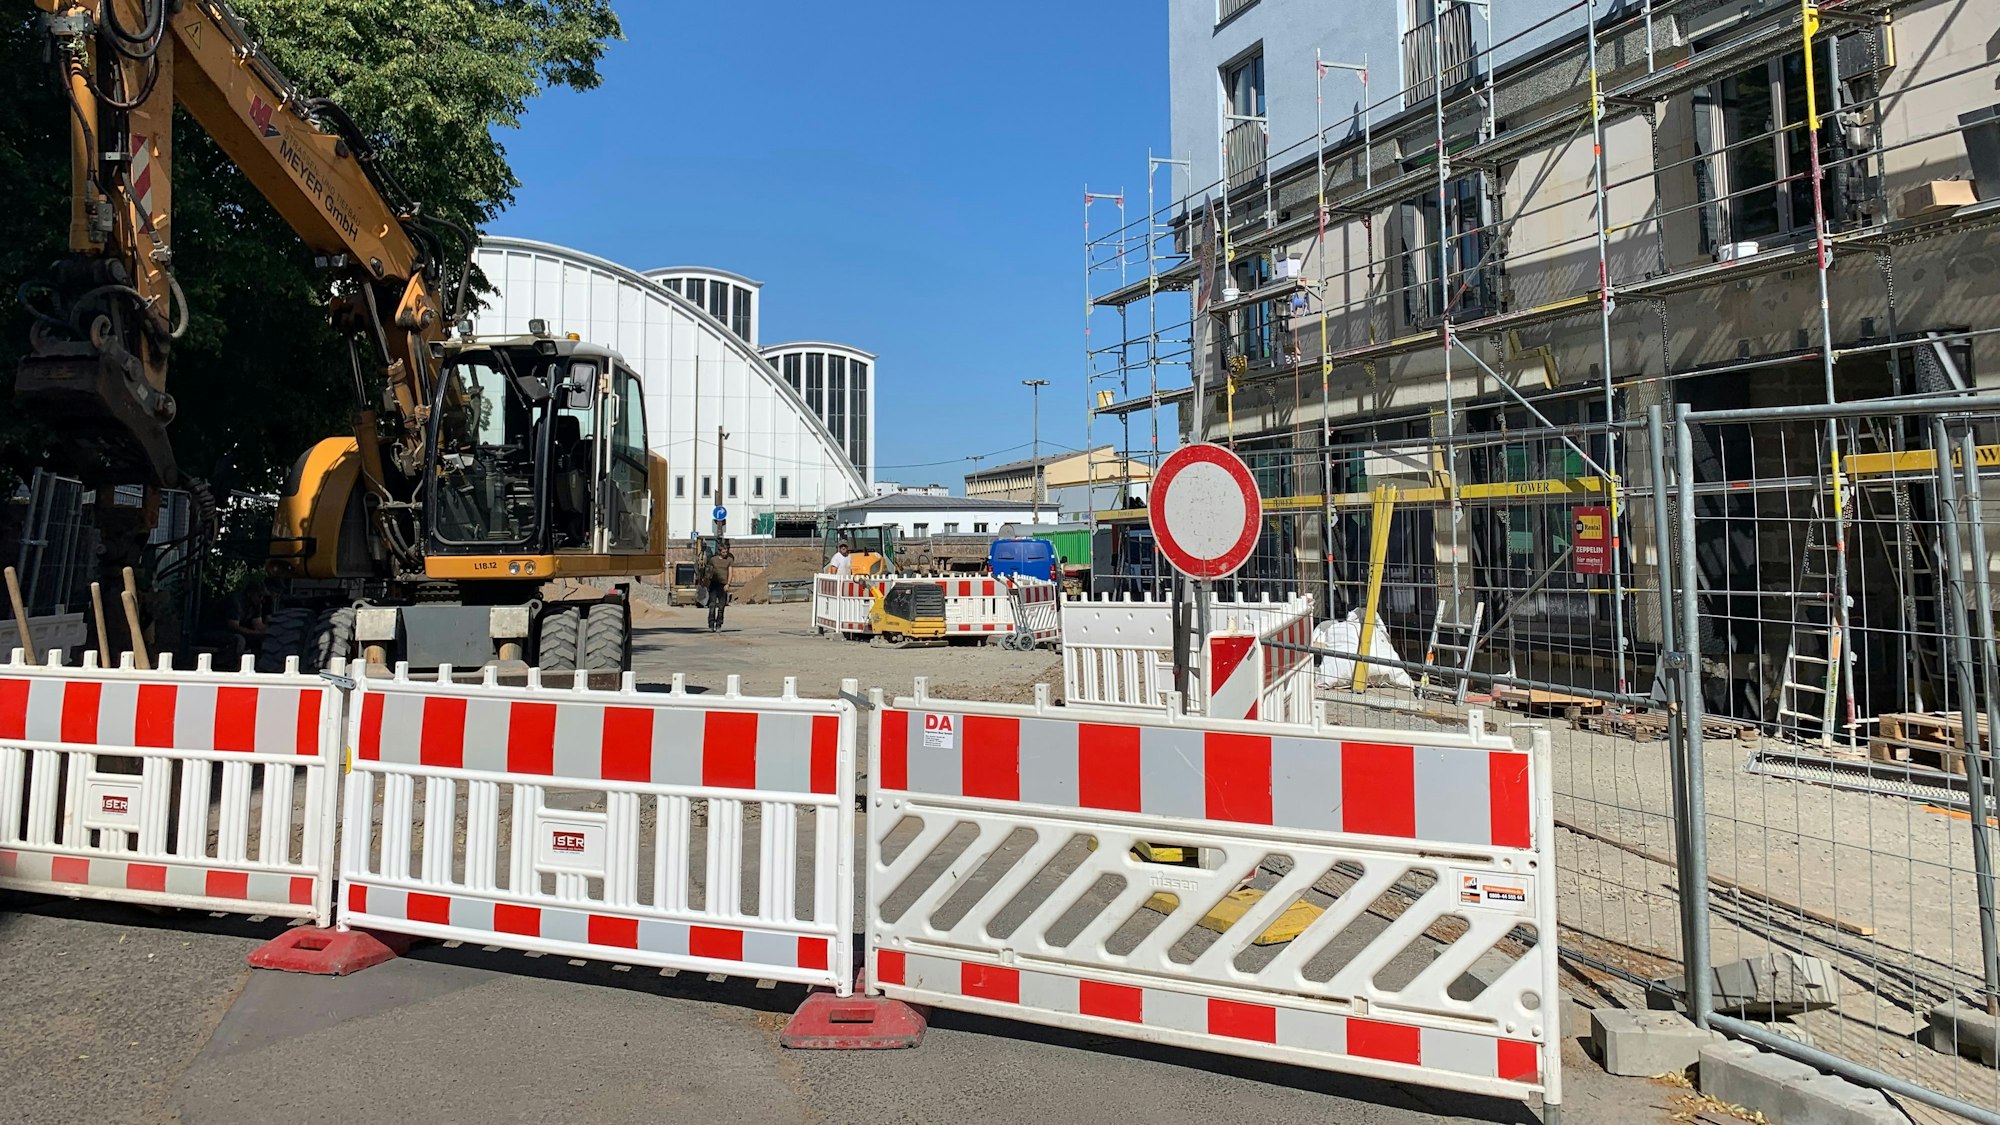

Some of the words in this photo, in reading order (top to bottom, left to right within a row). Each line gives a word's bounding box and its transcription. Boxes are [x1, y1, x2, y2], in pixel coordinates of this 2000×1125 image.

[280, 140, 323, 200] MEYER
[324, 195, 359, 242] GmbH
[1953, 446, 2000, 465] TW
[1515, 482, 1550, 494] TOWER
[1575, 546, 1604, 554] ZEPPELIN
[474, 562, 497, 570] L18.12
[925, 714, 952, 731] DA
[1150, 871, 1199, 891] nissen
